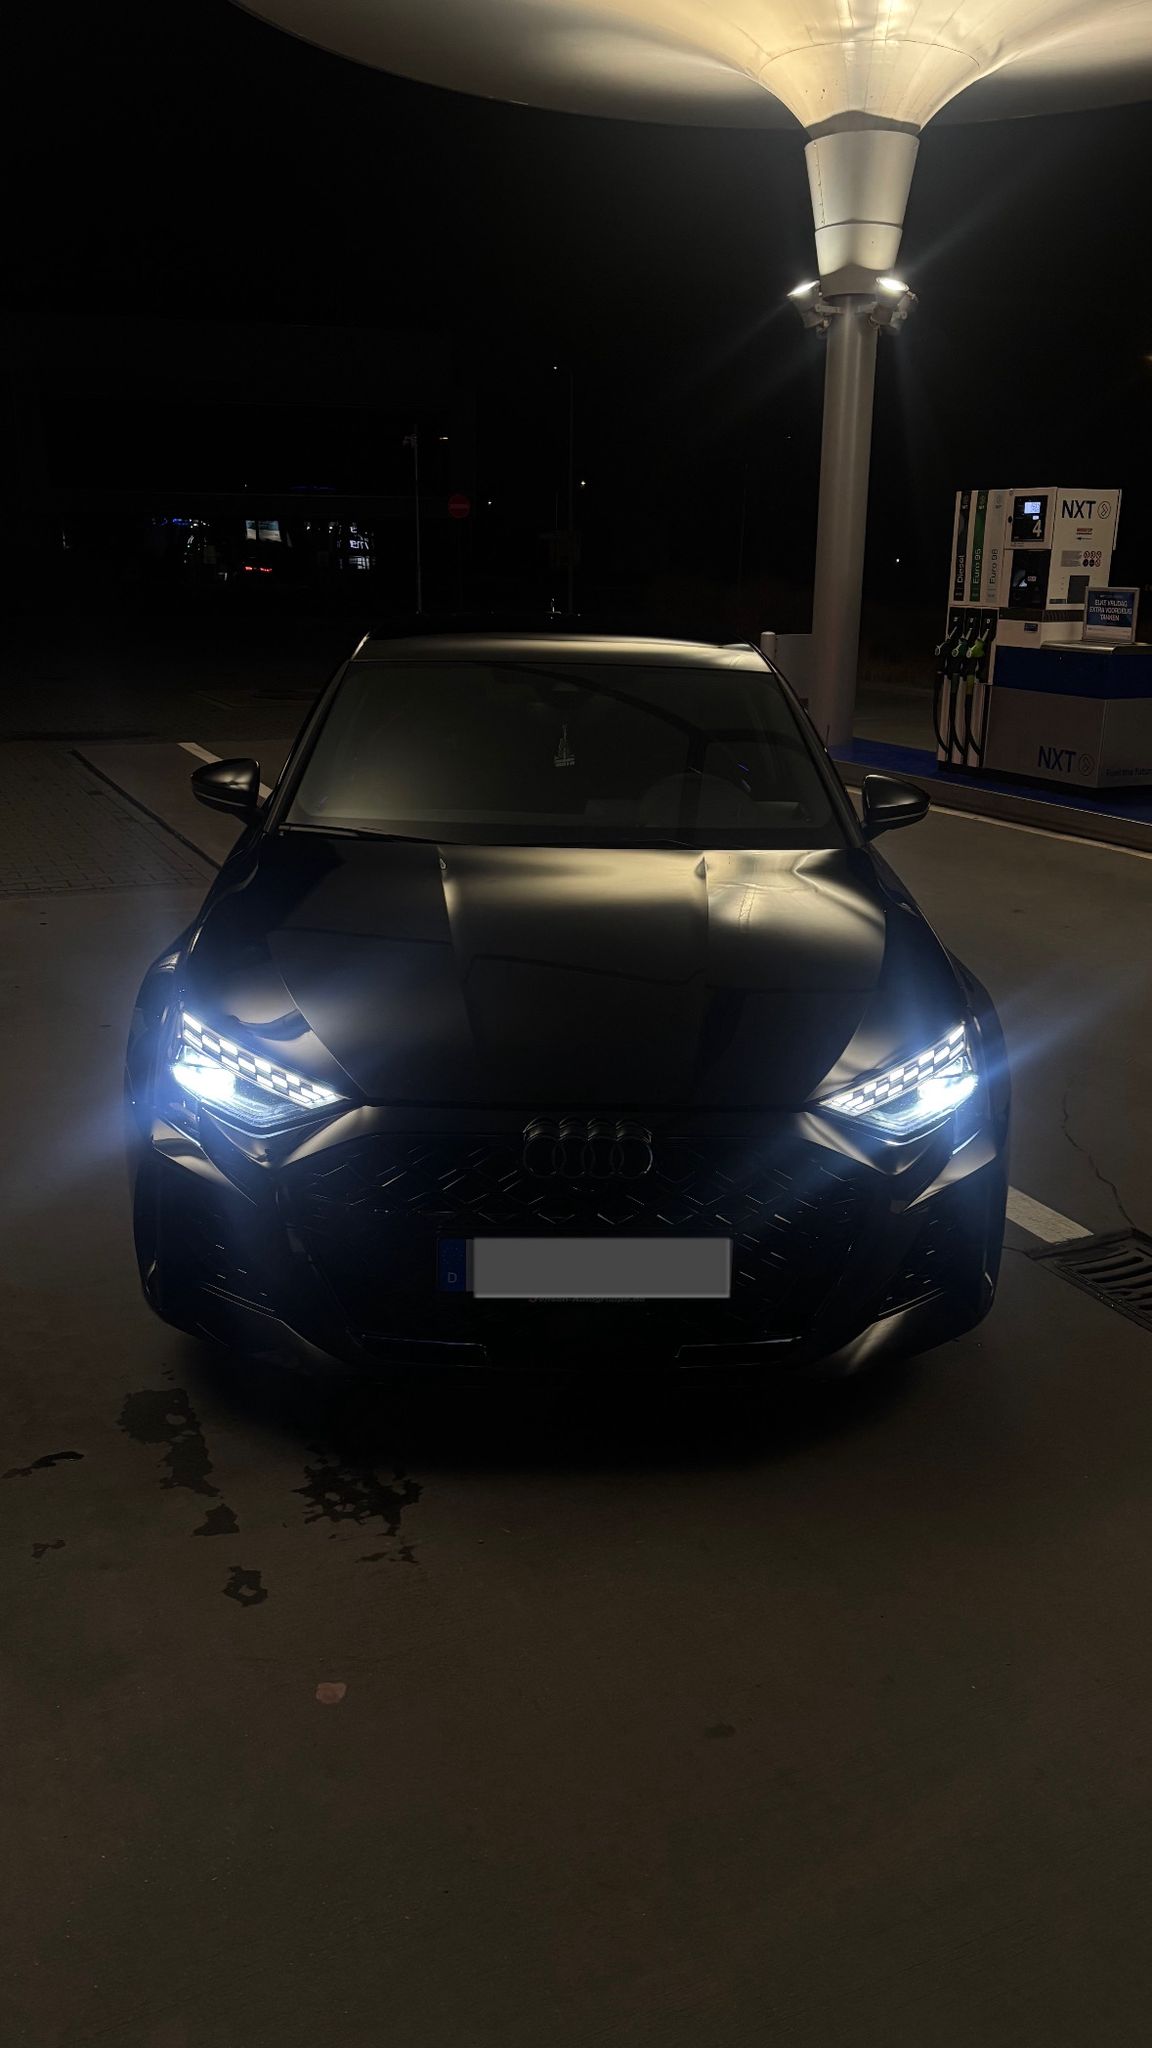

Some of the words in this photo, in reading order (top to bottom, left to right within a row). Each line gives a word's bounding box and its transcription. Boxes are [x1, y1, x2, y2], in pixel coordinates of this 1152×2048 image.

[1062, 500, 1096, 518] NXT
[1032, 520, 1042, 538] 4
[957, 555, 965, 583] Diesel
[1038, 746, 1076, 773] NXT
[447, 1272, 457, 1283] D
